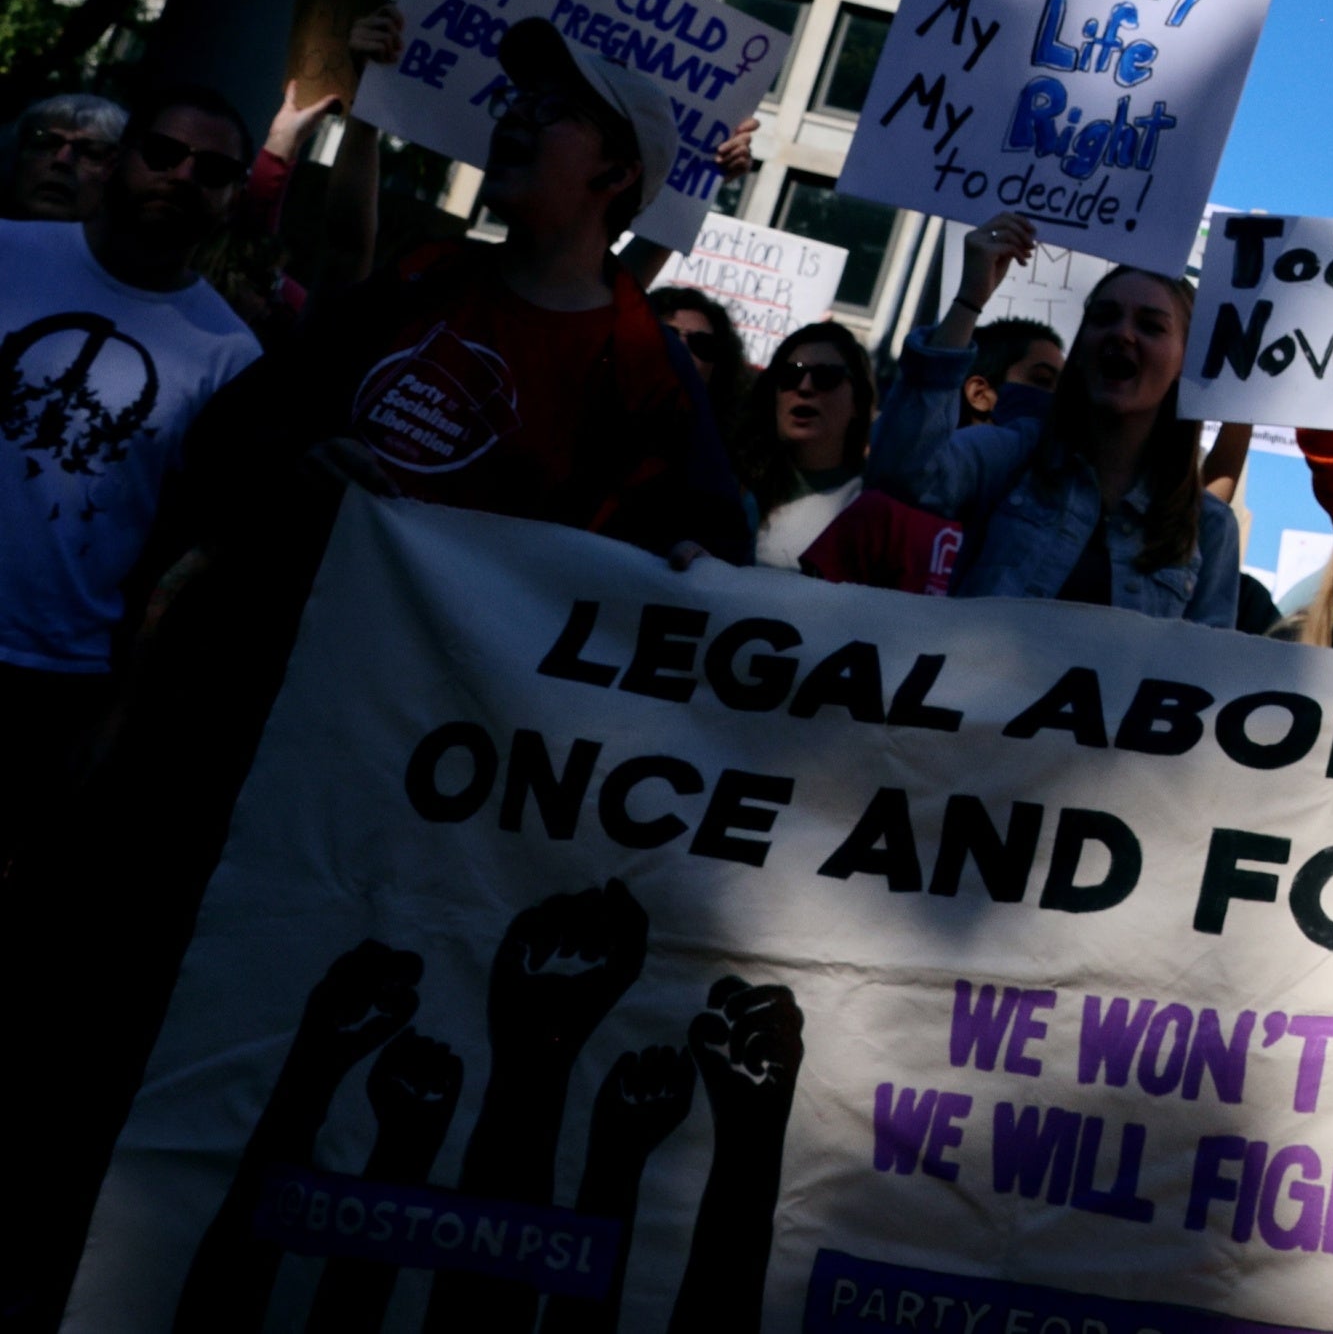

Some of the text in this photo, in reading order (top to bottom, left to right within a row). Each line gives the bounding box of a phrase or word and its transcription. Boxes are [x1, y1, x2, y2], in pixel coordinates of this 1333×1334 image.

[400, 40, 458, 89] BE
[881, 75, 1177, 178] My Right
[934, 147, 1153, 232] to decide!
[797, 246, 820, 278] is
[538, 600, 963, 733] LEGAL
[406, 722, 795, 867] ONCE
[818, 787, 1143, 914] AND
[949, 981, 1057, 1076] WE
[873, 1082, 972, 1182] WE
[992, 1102, 1154, 1222] WILL
[832, 1278, 991, 1334] PARTY
